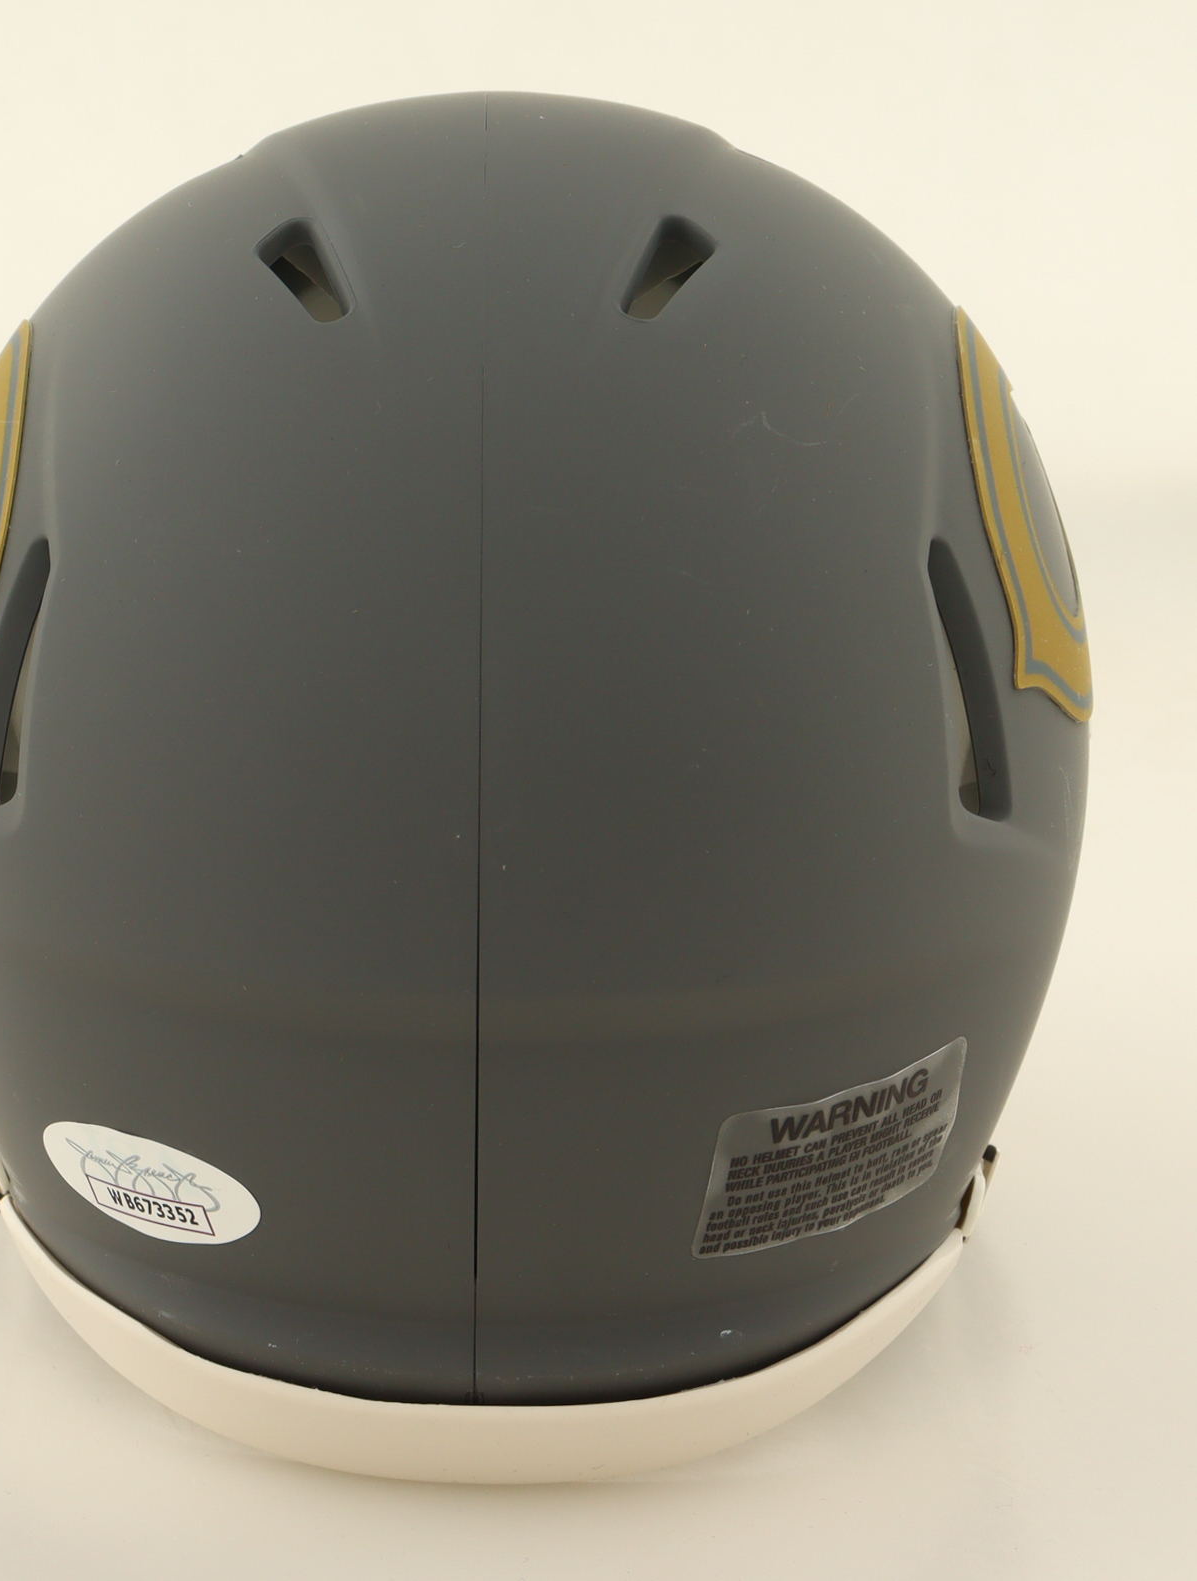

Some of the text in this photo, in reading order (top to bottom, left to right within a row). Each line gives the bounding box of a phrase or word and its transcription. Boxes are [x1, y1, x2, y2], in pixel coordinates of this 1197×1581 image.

[728, 1101, 940, 1181] NECK INJURIES A PLAYER MIGHT RECEIVE
[731, 1088, 943, 1169] NO HELMET CAN PREVENT ALL HEAD OR
[770, 1068, 929, 1144] WARNING
[107, 1186, 199, 1225] WB673352
[703, 1231, 730, 1243] head
[734, 1228, 745, 1238] or
[750, 1221, 774, 1236] neck
[823, 1196, 866, 1219] paralysis
[869, 1189, 879, 1200] or
[907, 1170, 916, 1181] to
[707, 1216, 749, 1232] football
[753, 1209, 779, 1224] rules
[783, 1204, 802, 1218] and
[805, 1197, 829, 1211] such
[832, 1191, 850, 1204] use
[851, 1184, 868, 1198] can
[870, 1169, 896, 1189] result
[710, 1211, 724, 1221] an
[729, 1200, 781, 1219] opposing
[786, 1190, 821, 1208] player.
[827, 1181, 846, 1195] This
[851, 1175, 859, 1187] is
[875, 1149, 915, 1177] violation
[726, 1176, 763, 1193] WHILE
[766, 1154, 846, 1187] PARTICIPATING
[849, 1149, 860, 1163] IN
[728, 1196, 741, 1207] Do
[746, 1191, 764, 1204] not
[769, 1187, 787, 1198] use
[792, 1180, 811, 1194] this
[815, 1167, 851, 1188] Helmet
[855, 1163, 864, 1175] to
[912, 1136, 921, 1149] or
[700, 1242, 720, 1255] and
[724, 1233, 769, 1252] possible
[772, 1225, 803, 1241] injury
[805, 1221, 815, 1232] to
[817, 1214, 842, 1231] your
